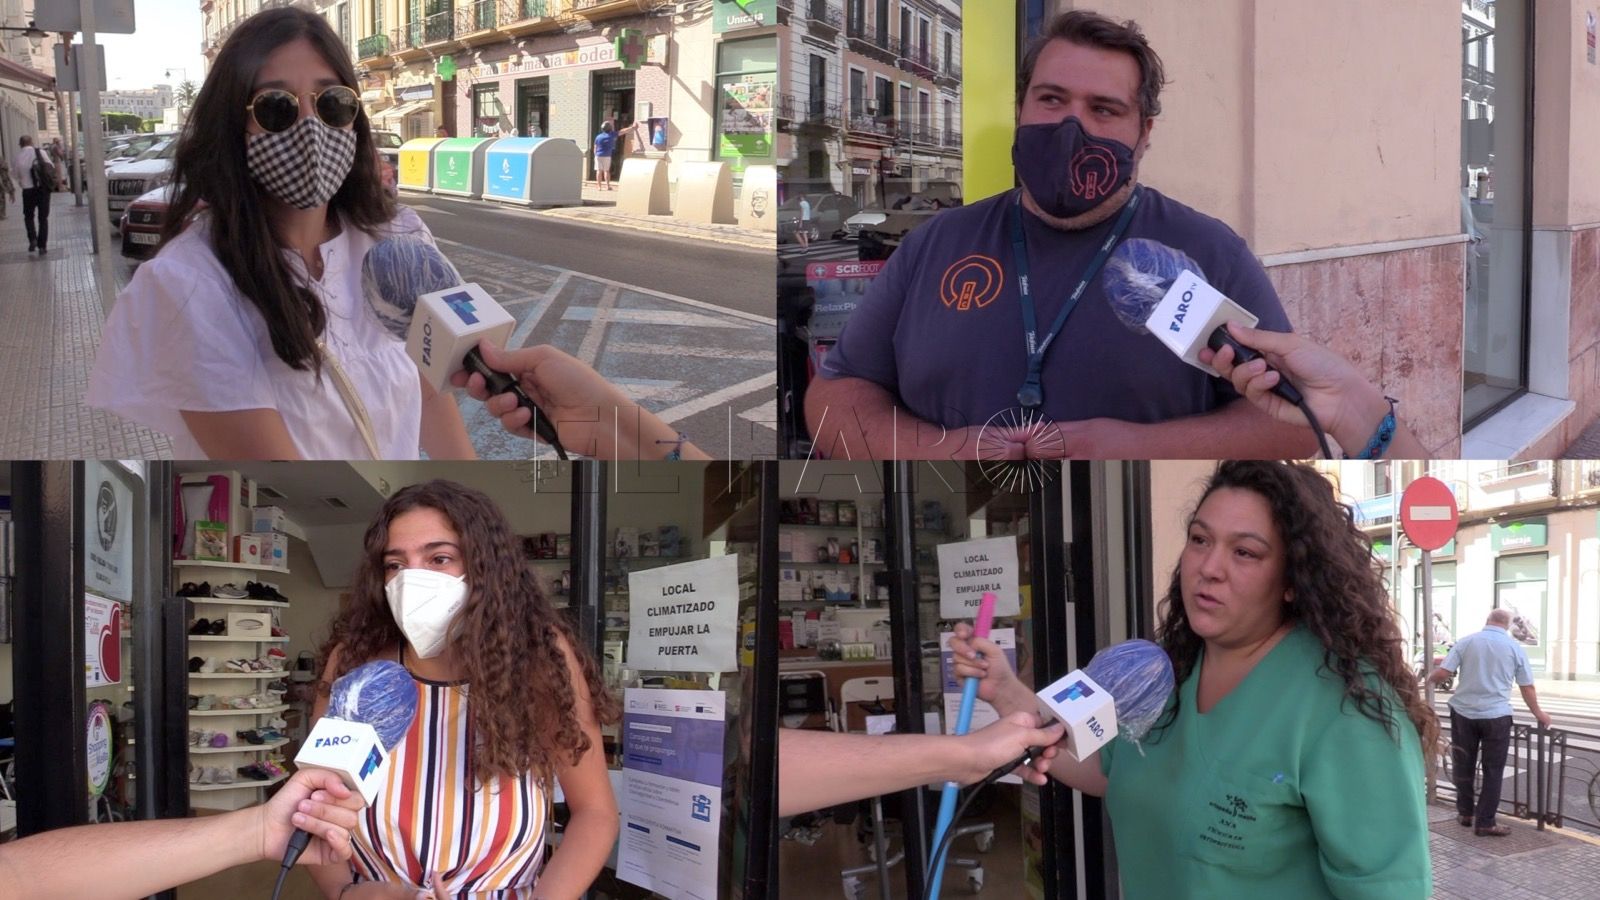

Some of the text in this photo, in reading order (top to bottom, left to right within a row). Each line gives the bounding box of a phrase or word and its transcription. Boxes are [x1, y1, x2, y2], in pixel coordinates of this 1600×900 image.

[726, 12, 764, 25] Unicaja
[501, 54, 562, 73] Farmacia
[1169, 290, 1193, 332] FARO
[422, 323, 432, 367] FARO
[964, 554, 989, 564] LOCAL
[953, 567, 1003, 579] CLIMATIZADO
[662, 583, 696, 596] LOCAL
[956, 583, 1001, 594] EMPUJAR LA
[647, 600, 715, 617] CLIMATIZADO
[649, 623, 710, 637] EMPUJAR LA
[658, 645, 698, 656] PUERTA
[1086, 716, 1104, 738] FARO
[315, 735, 352, 749] FARO
